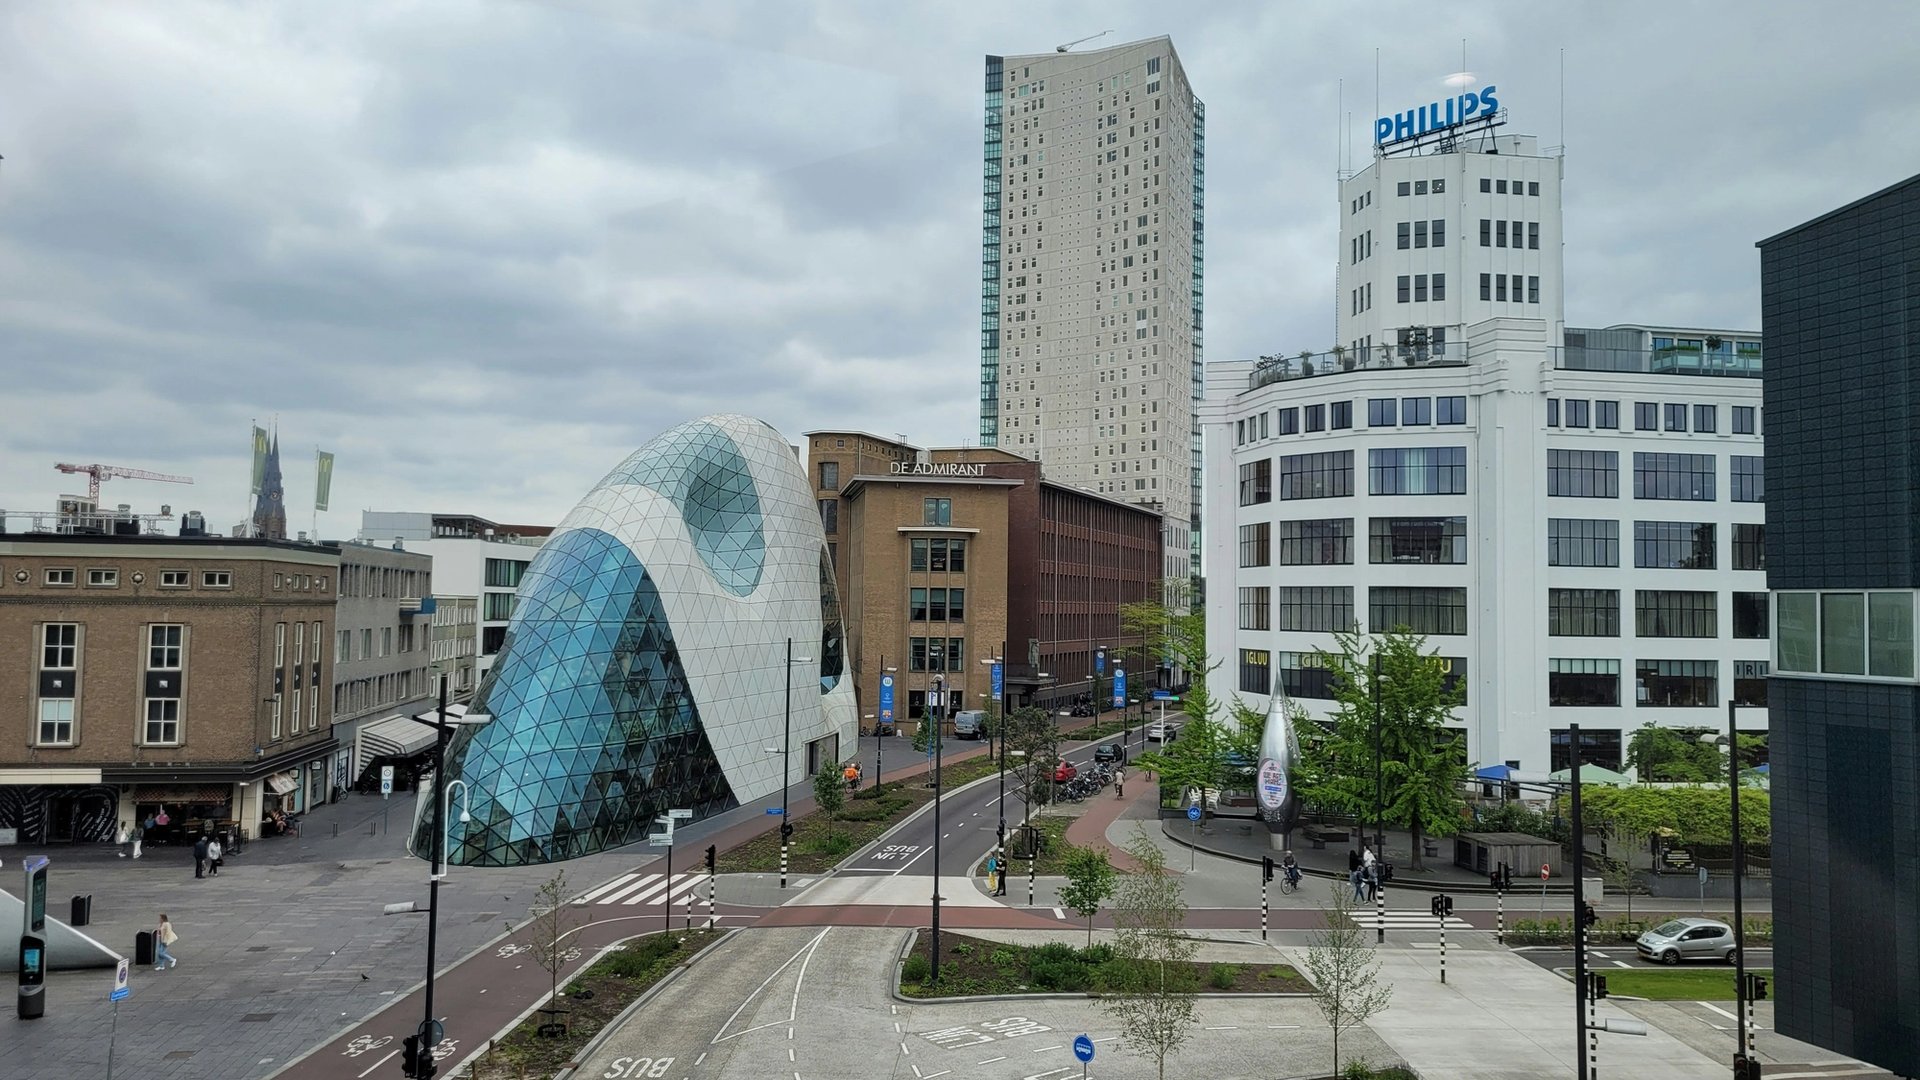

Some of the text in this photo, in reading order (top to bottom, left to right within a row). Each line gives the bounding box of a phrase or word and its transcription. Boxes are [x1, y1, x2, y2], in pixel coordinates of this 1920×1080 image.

[1374, 85, 1498, 145] PHILIPS
[890, 461, 987, 476] DE ADMIRANT
[1245, 650, 1268, 666] IGLUU
[882, 844, 919, 853] BUS
[980, 1016, 1052, 1038] BUS
[603, 1056, 676, 1079] BUS
